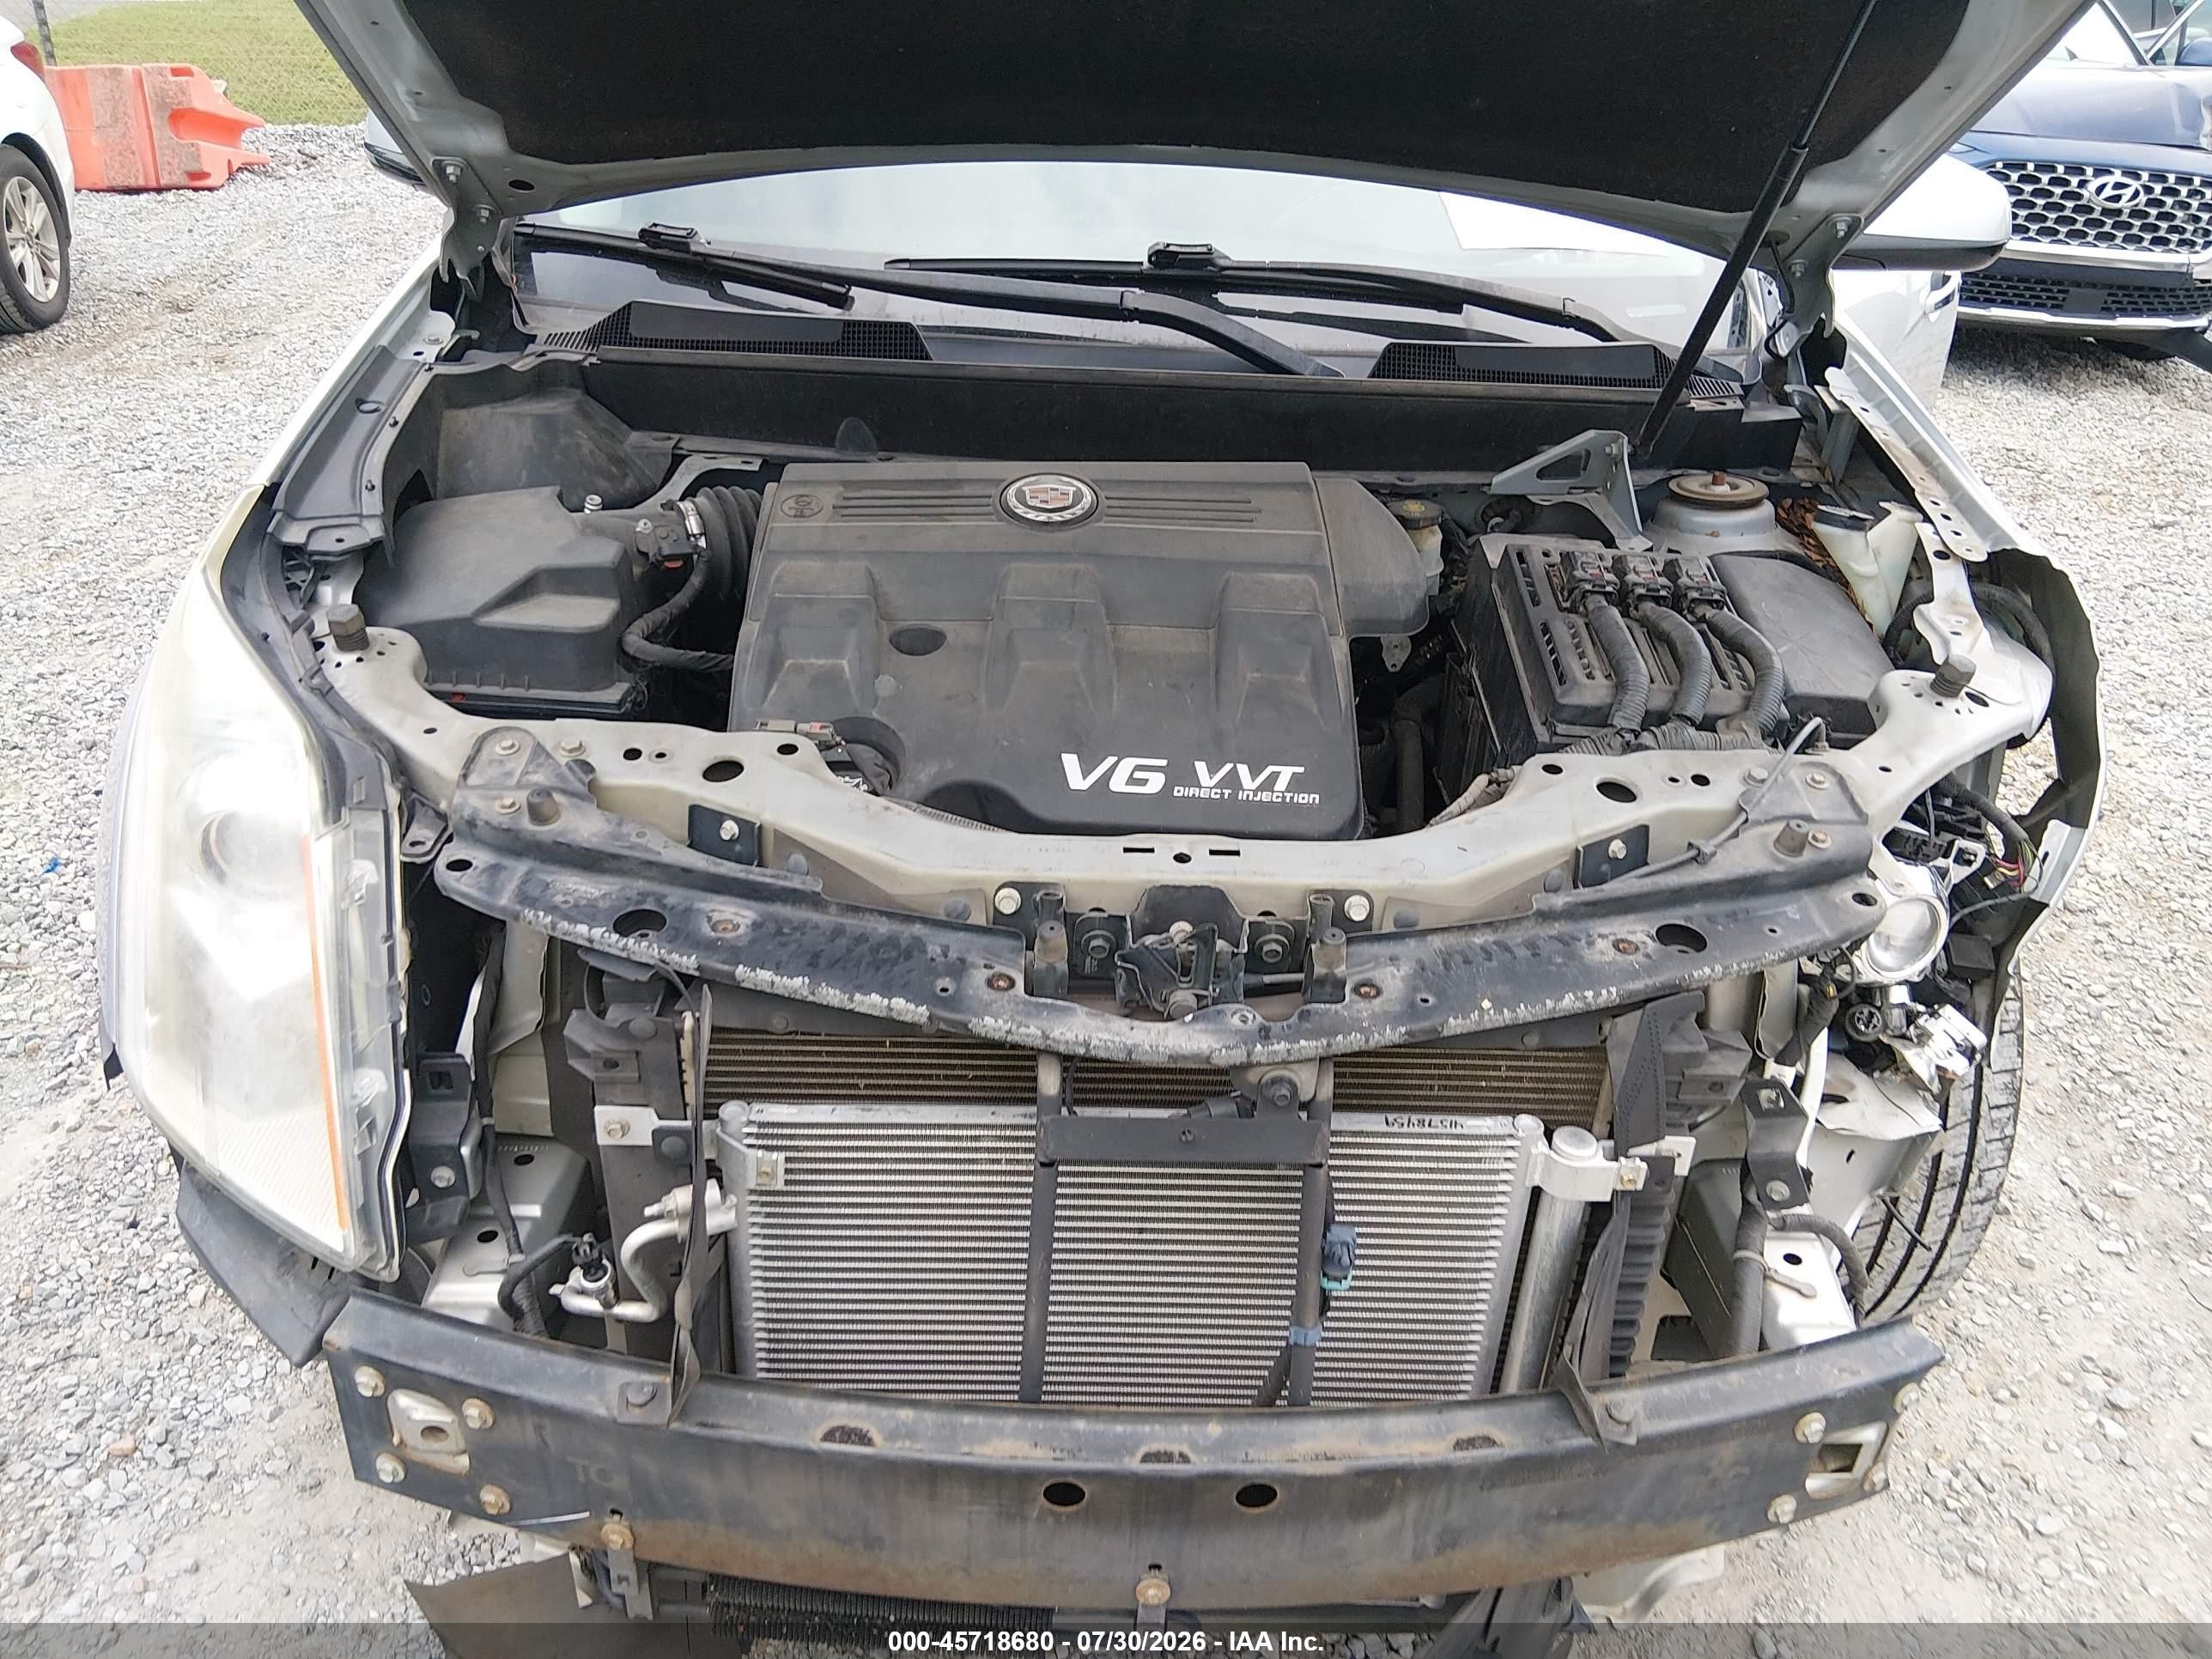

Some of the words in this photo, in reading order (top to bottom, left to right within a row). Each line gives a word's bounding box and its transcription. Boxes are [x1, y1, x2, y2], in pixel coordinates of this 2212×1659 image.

[1060, 752, 1169, 794] V6
[1194, 760, 1305, 792] VVT
[1173, 786, 1232, 800] DIRECT
[1237, 789, 1320, 805] INJECTION
